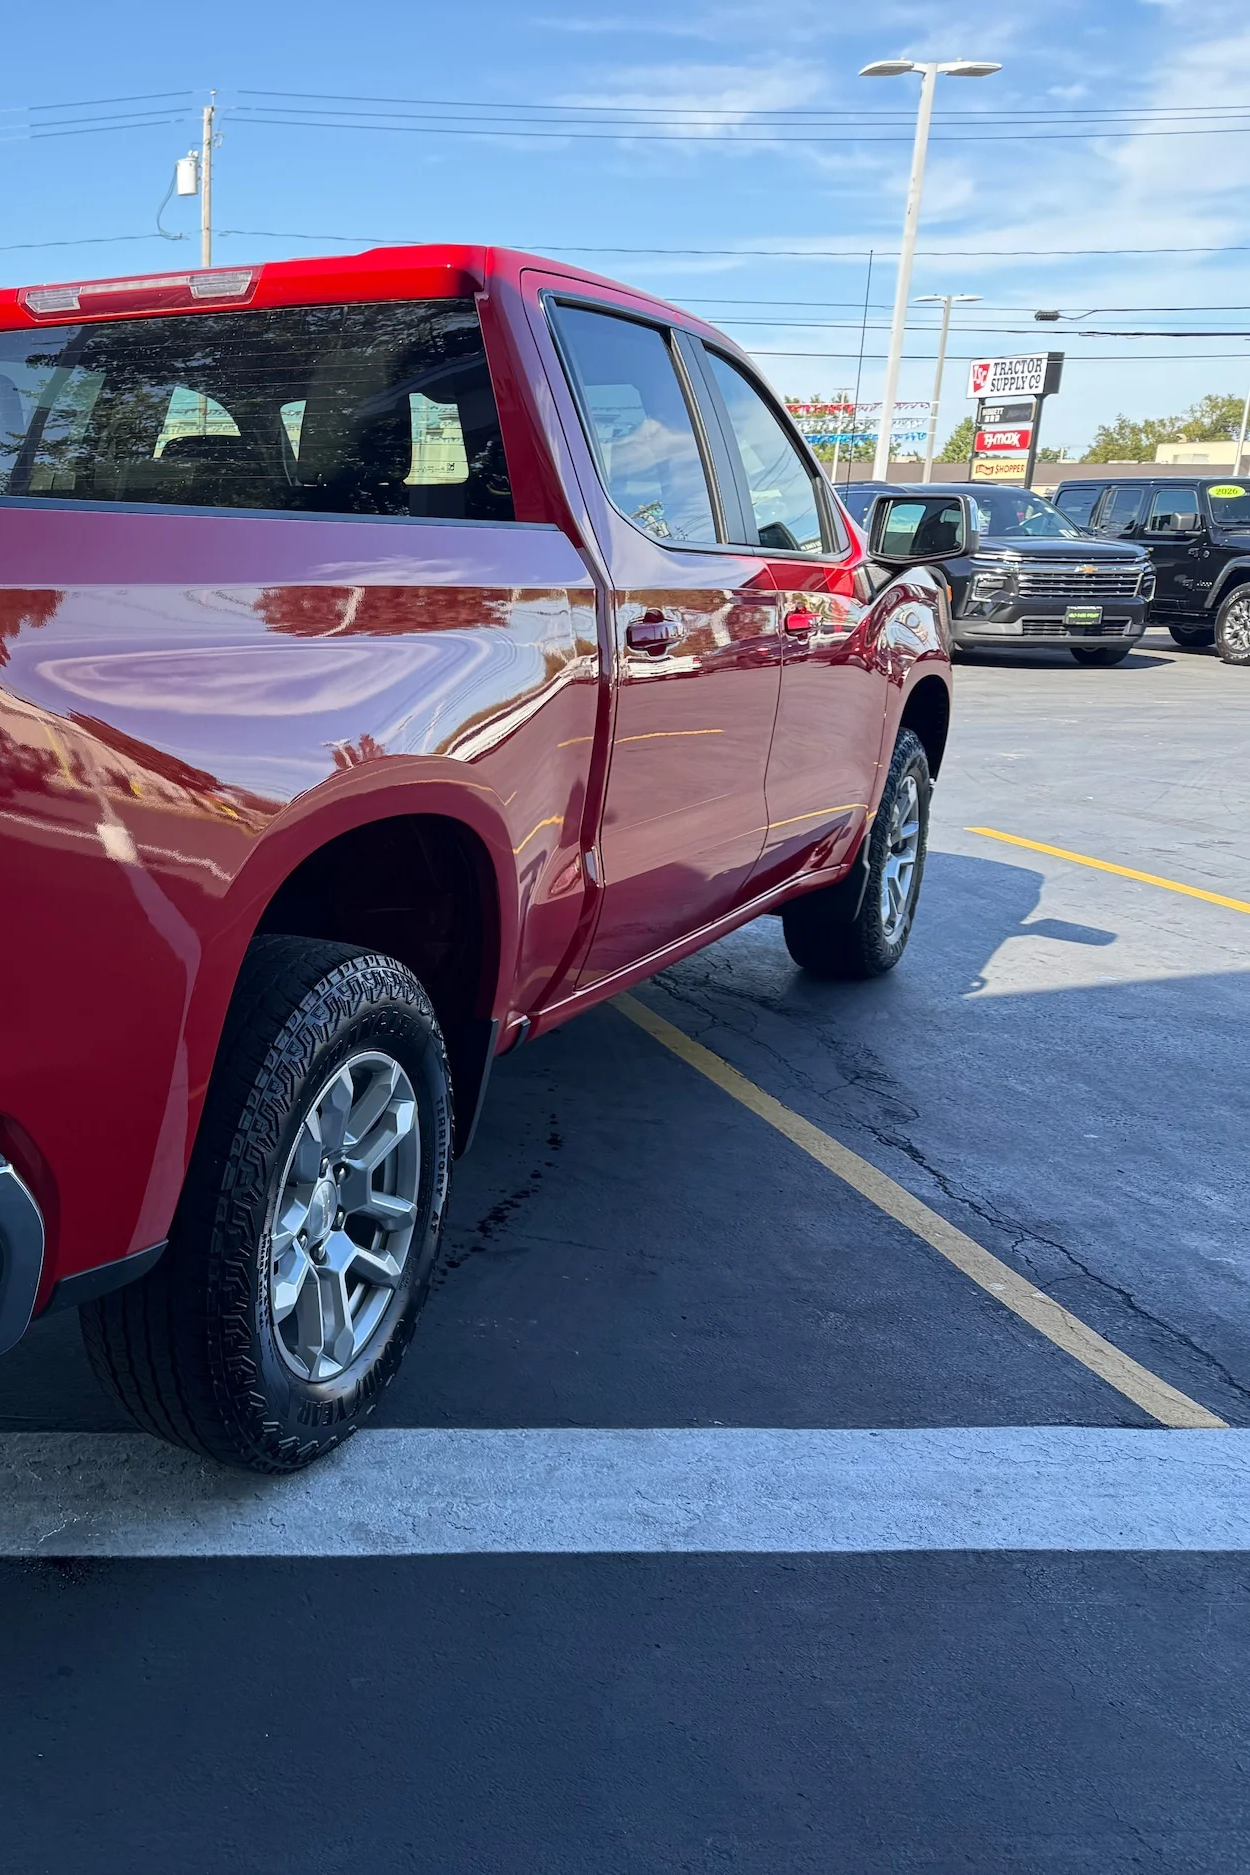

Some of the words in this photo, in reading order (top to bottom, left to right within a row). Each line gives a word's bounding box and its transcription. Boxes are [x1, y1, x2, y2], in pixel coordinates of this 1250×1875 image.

[993, 359, 1043, 376] TRACTOR
[990, 376, 1028, 393] SUPPLY
[435, 1095, 446, 1197] TERRITORY
